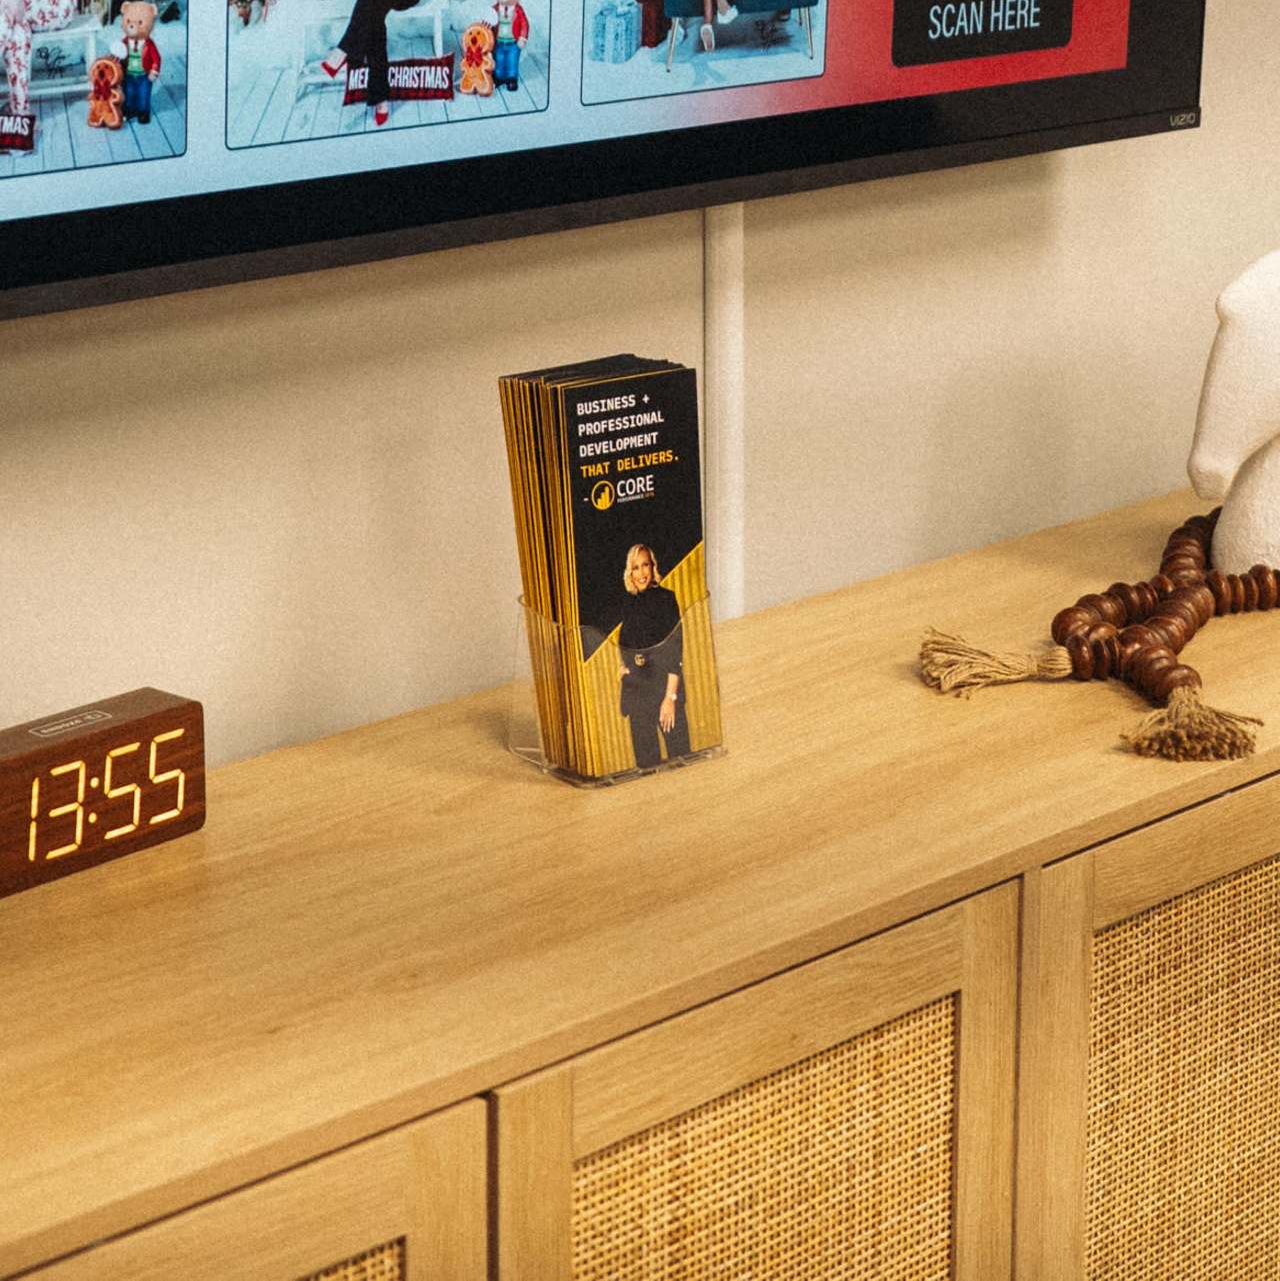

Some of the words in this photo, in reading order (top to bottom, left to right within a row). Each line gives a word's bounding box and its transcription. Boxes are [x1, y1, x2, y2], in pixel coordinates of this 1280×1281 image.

[928, 0, 984, 40] SCAN
[388, 65, 449, 89] CHRISTMAS
[576, 394, 636, 416] BUSINESS
[577, 410, 665, 437] PROFESSIONAL
[579, 431, 659, 458] DEVELOPMENT
[580, 461, 610, 478] THAT
[617, 449, 679, 471] DELIVERS.
[616, 474, 655, 497] CORE
[27, 727, 185, 862] 13:55
